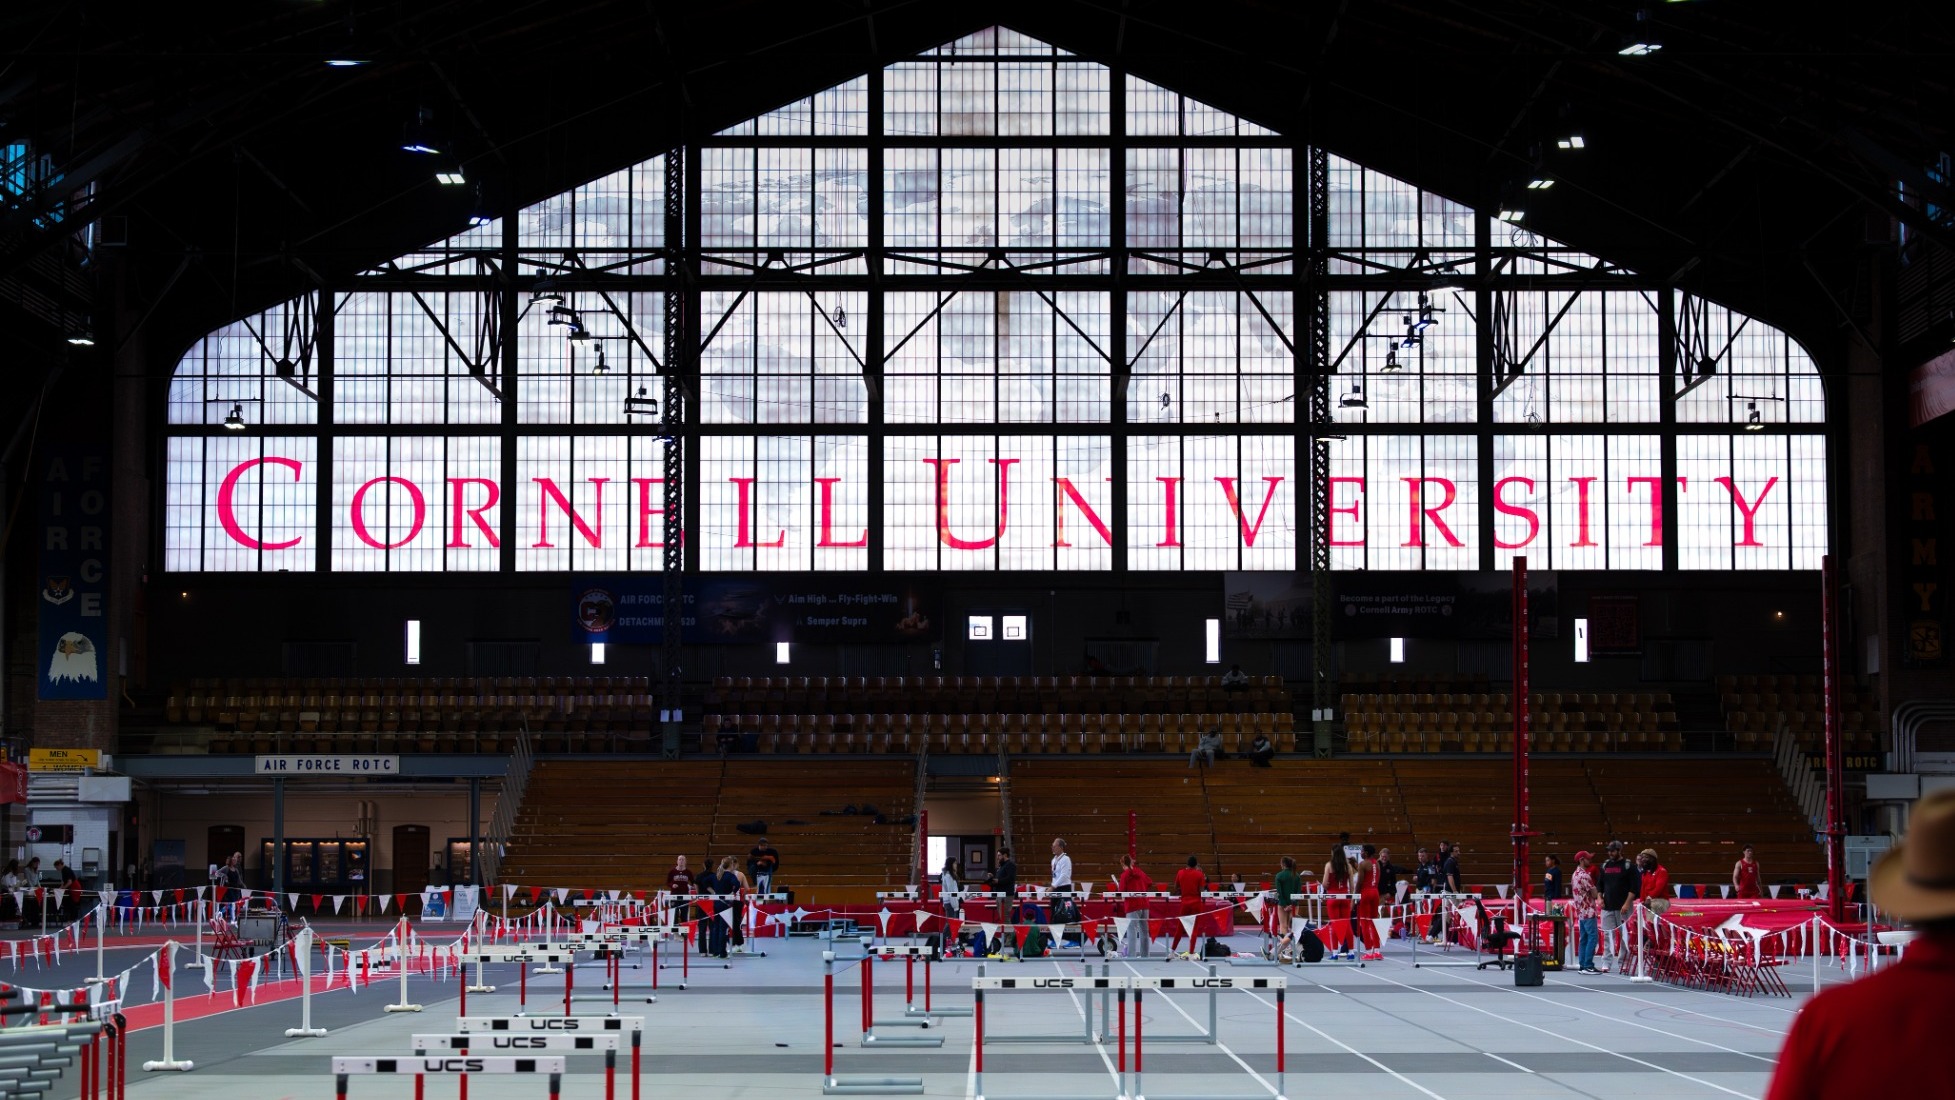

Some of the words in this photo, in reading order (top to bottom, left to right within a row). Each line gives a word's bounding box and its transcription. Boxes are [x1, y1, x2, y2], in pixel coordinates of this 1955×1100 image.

[45, 456, 70, 551] AIR
[217, 456, 868, 551] CORNELL
[924, 458, 1778, 551] UNIVERSITY
[1909, 442, 1938, 612] ARMY
[79, 455, 105, 617] FORCE
[620, 594, 637, 605] AIR
[638, 594, 665, 605] FORC
[788, 594, 805, 604] Aim
[806, 594, 827, 606] High
[838, 594, 898, 606] Fly-Fight-Win
[1340, 594, 1373, 603] Become
[1381, 595, 1399, 605] part
[1410, 594, 1425, 603] the
[1425, 594, 1456, 605] Legacy
[1360, 606, 1391, 614] Cornell
[1391, 606, 1414, 616] Army
[1414, 606, 1438, 614] ROTC
[619, 616, 665, 627] DETACHM
[807, 616, 841, 628] Semper
[842, 616, 868, 628] Supra
[264, 759, 287, 771] AIR
[297, 759, 341, 771] FORCE
[352, 759, 391, 771] ROTC
[1846, 756, 1877, 769] ROTC
[1033, 979, 1074, 988] UCS
[1192, 979, 1233, 988] UCS
[530, 1019, 579, 1030] UCS
[493, 1036, 547, 1049] UCS
[424, 1059, 484, 1072] UCS
